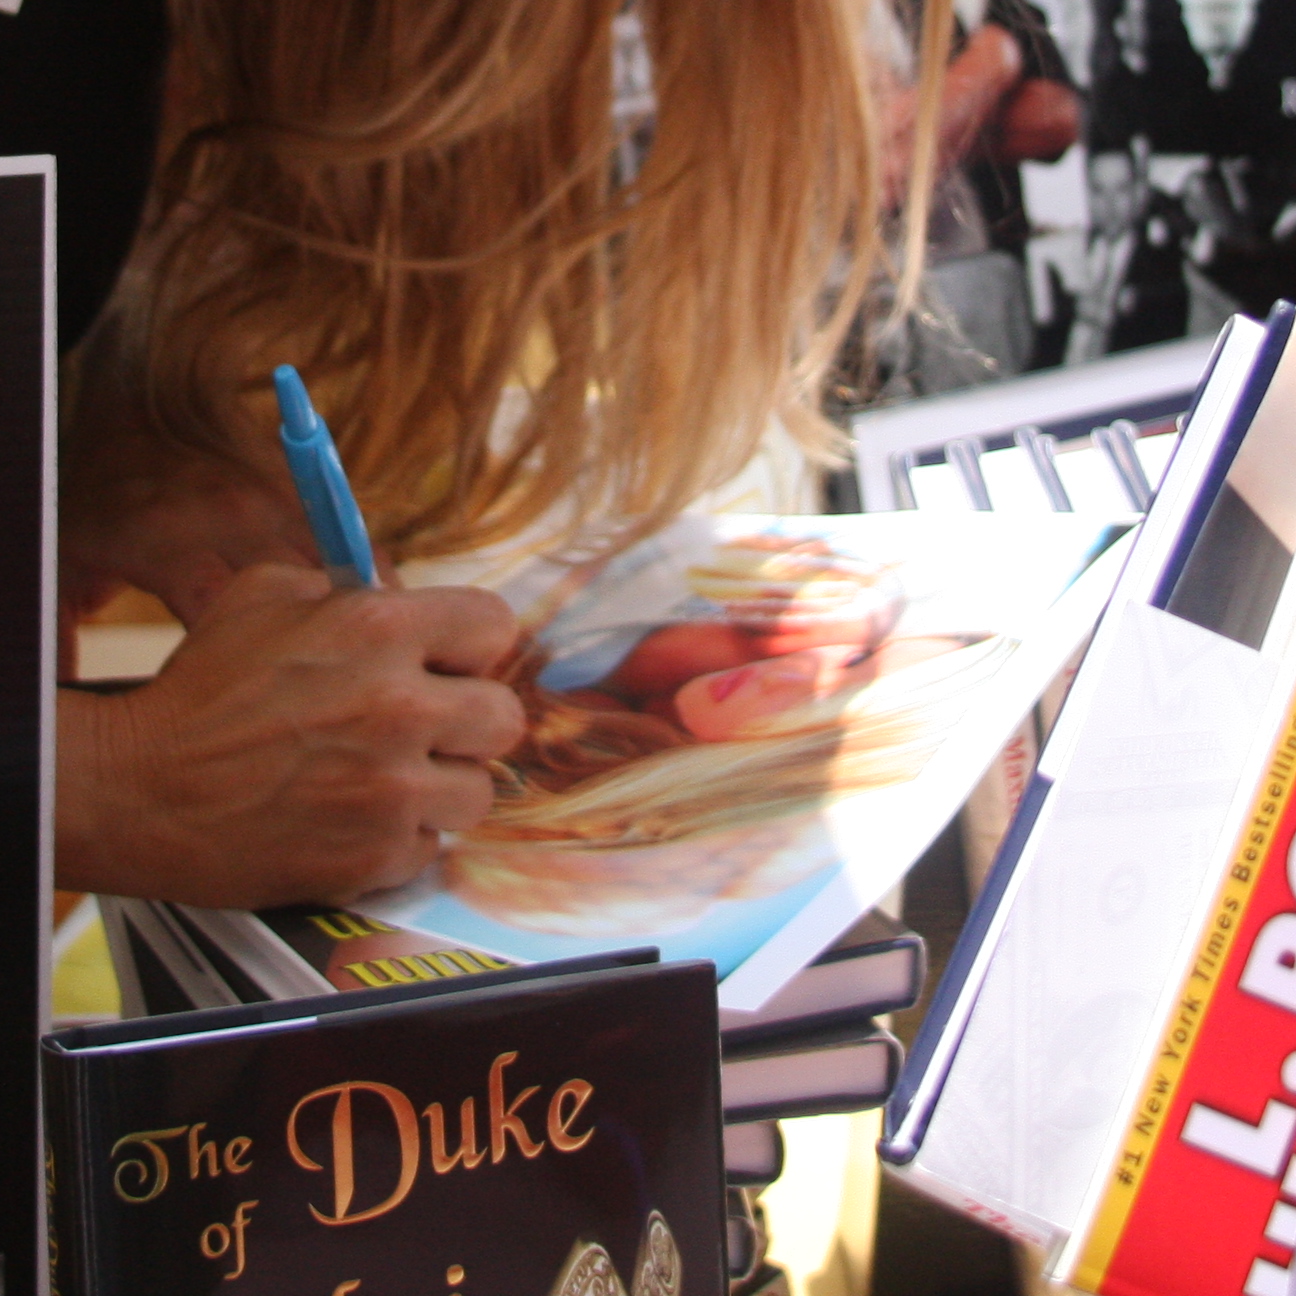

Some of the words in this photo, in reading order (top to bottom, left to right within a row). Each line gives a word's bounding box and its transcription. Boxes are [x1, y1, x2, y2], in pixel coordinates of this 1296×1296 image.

[1114, 1148, 1144, 1188] #1
[1132, 1076, 1172, 1138] New
[1161, 997, 1202, 1060] York
[1190, 895, 1242, 982] Times
[110, 1120, 254, 1204] The
[286, 1050, 595, 1227] Duke
[199, 1199, 260, 1281] of
